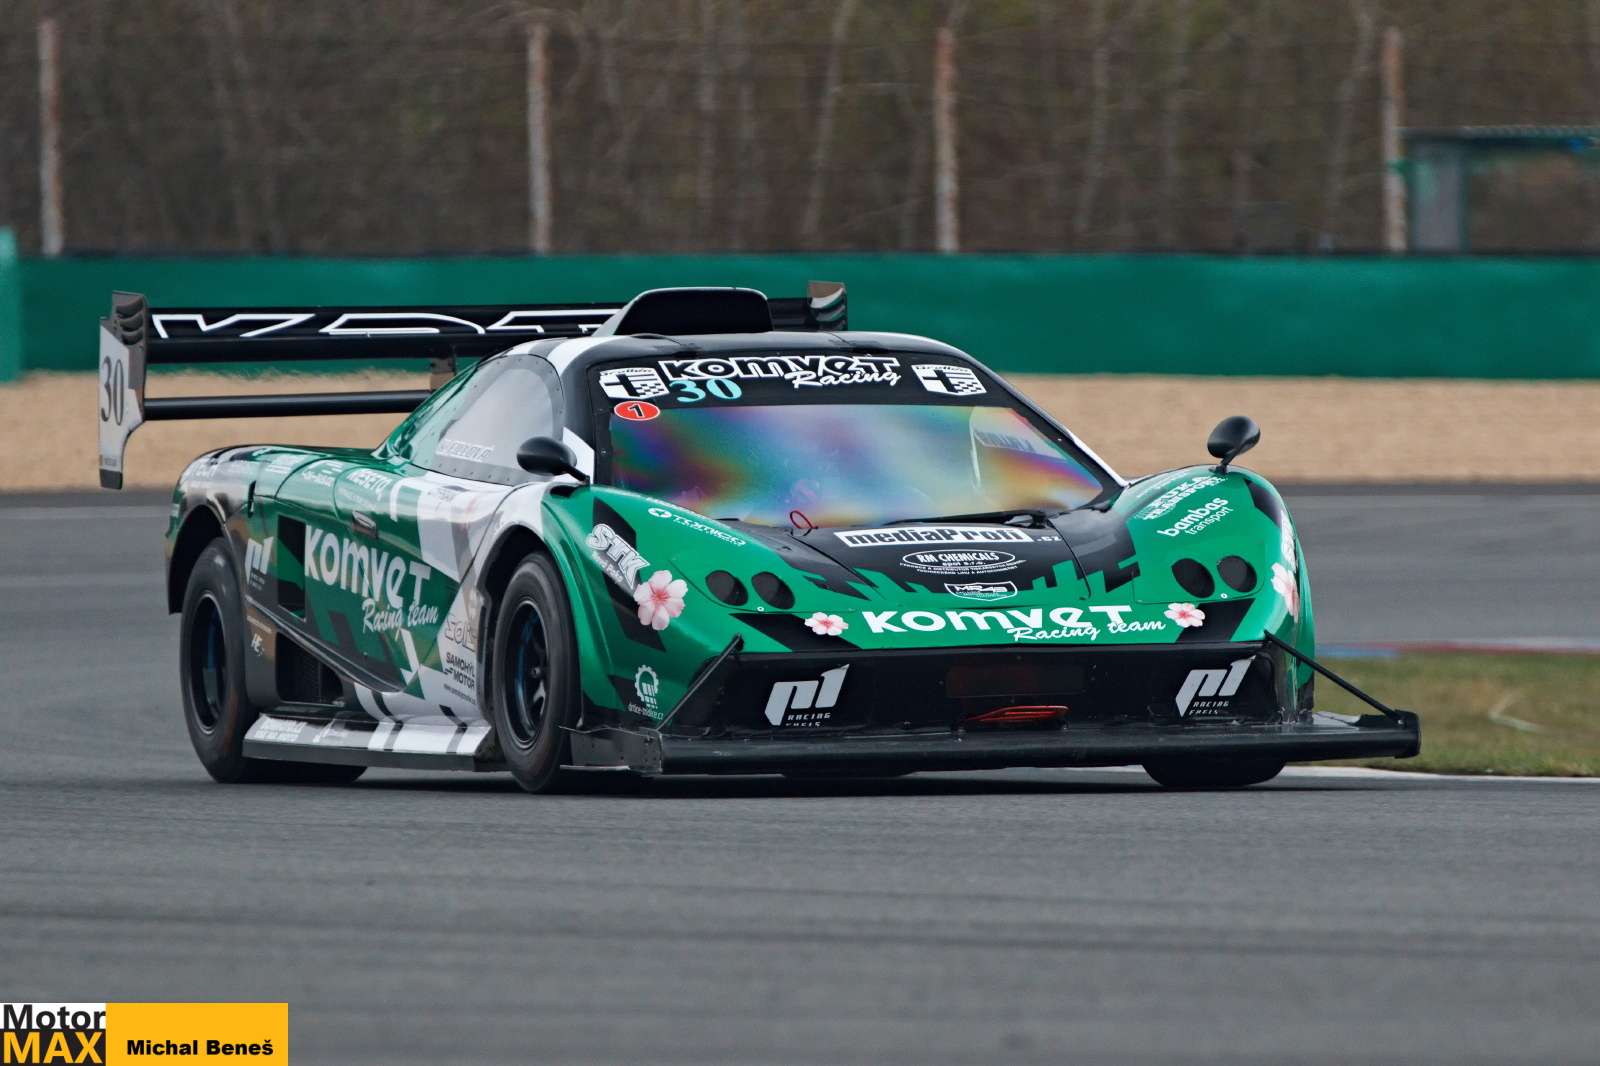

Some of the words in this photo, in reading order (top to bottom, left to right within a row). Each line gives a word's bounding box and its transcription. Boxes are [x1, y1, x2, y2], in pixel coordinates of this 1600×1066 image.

[100, 356, 125, 426] 30
[669, 378, 743, 403] 30
[783, 370, 902, 389] Racing
[1157, 497, 1229, 537] bambas
[1184, 507, 1234, 535] transport
[586, 523, 651, 591] STK
[915, 554, 938, 563] RM
[938, 552, 1000, 562] CHEMICALS
[362, 598, 403, 640] Racing
[407, 601, 439, 627] team
[1007, 625, 1101, 641] Racing
[1108, 618, 1167, 633] team
[453, 669, 475, 689] MOTOR
[1192, 700, 1230, 708] RACING
[787, 712, 832, 721] RACING
